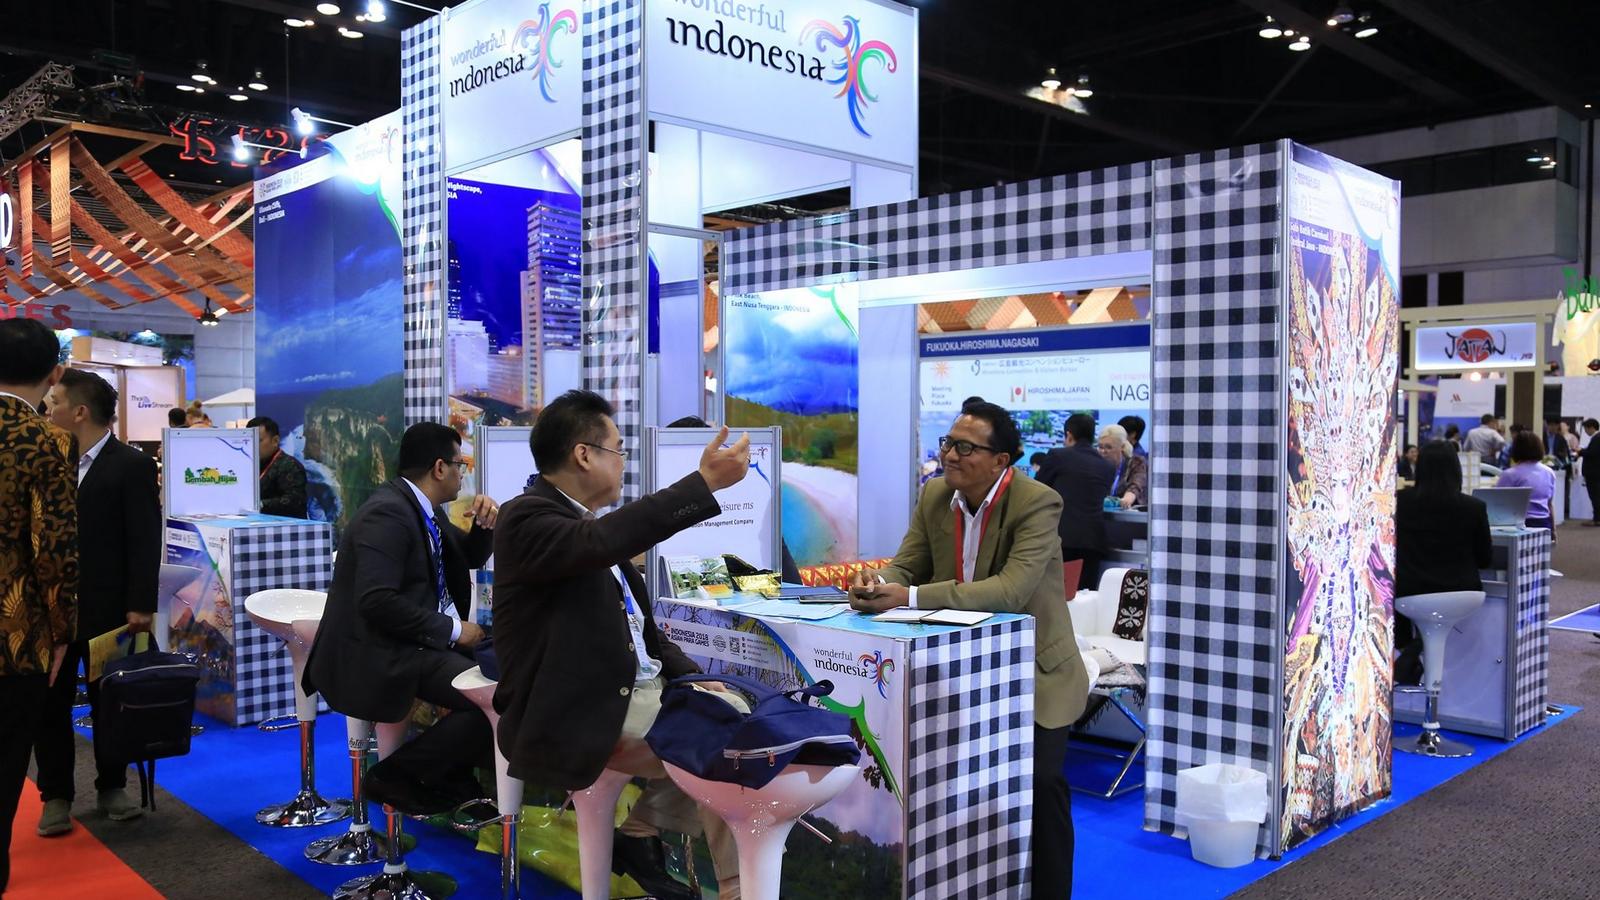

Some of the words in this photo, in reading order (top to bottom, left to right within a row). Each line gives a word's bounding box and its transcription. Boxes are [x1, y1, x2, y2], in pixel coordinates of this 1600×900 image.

[450, 29, 506, 67] wonderful
[666, 17, 826, 81] indonesia
[450, 54, 526, 98] indonesia
[758, 302, 780, 311] Tenggara
[1444, 329, 1506, 360] JAPAN
[704, 519, 733, 527] Management
[734, 518, 754, 526] Company
[671, 627, 696, 638] INDONESIA
[696, 632, 709, 641] 2018
[671, 634, 683, 642] ASIAN
[684, 636, 695, 644] PARA
[695, 638, 710, 647] GAMES
[813, 647, 853, 661] wonderful
[814, 658, 868, 678] indonesia
